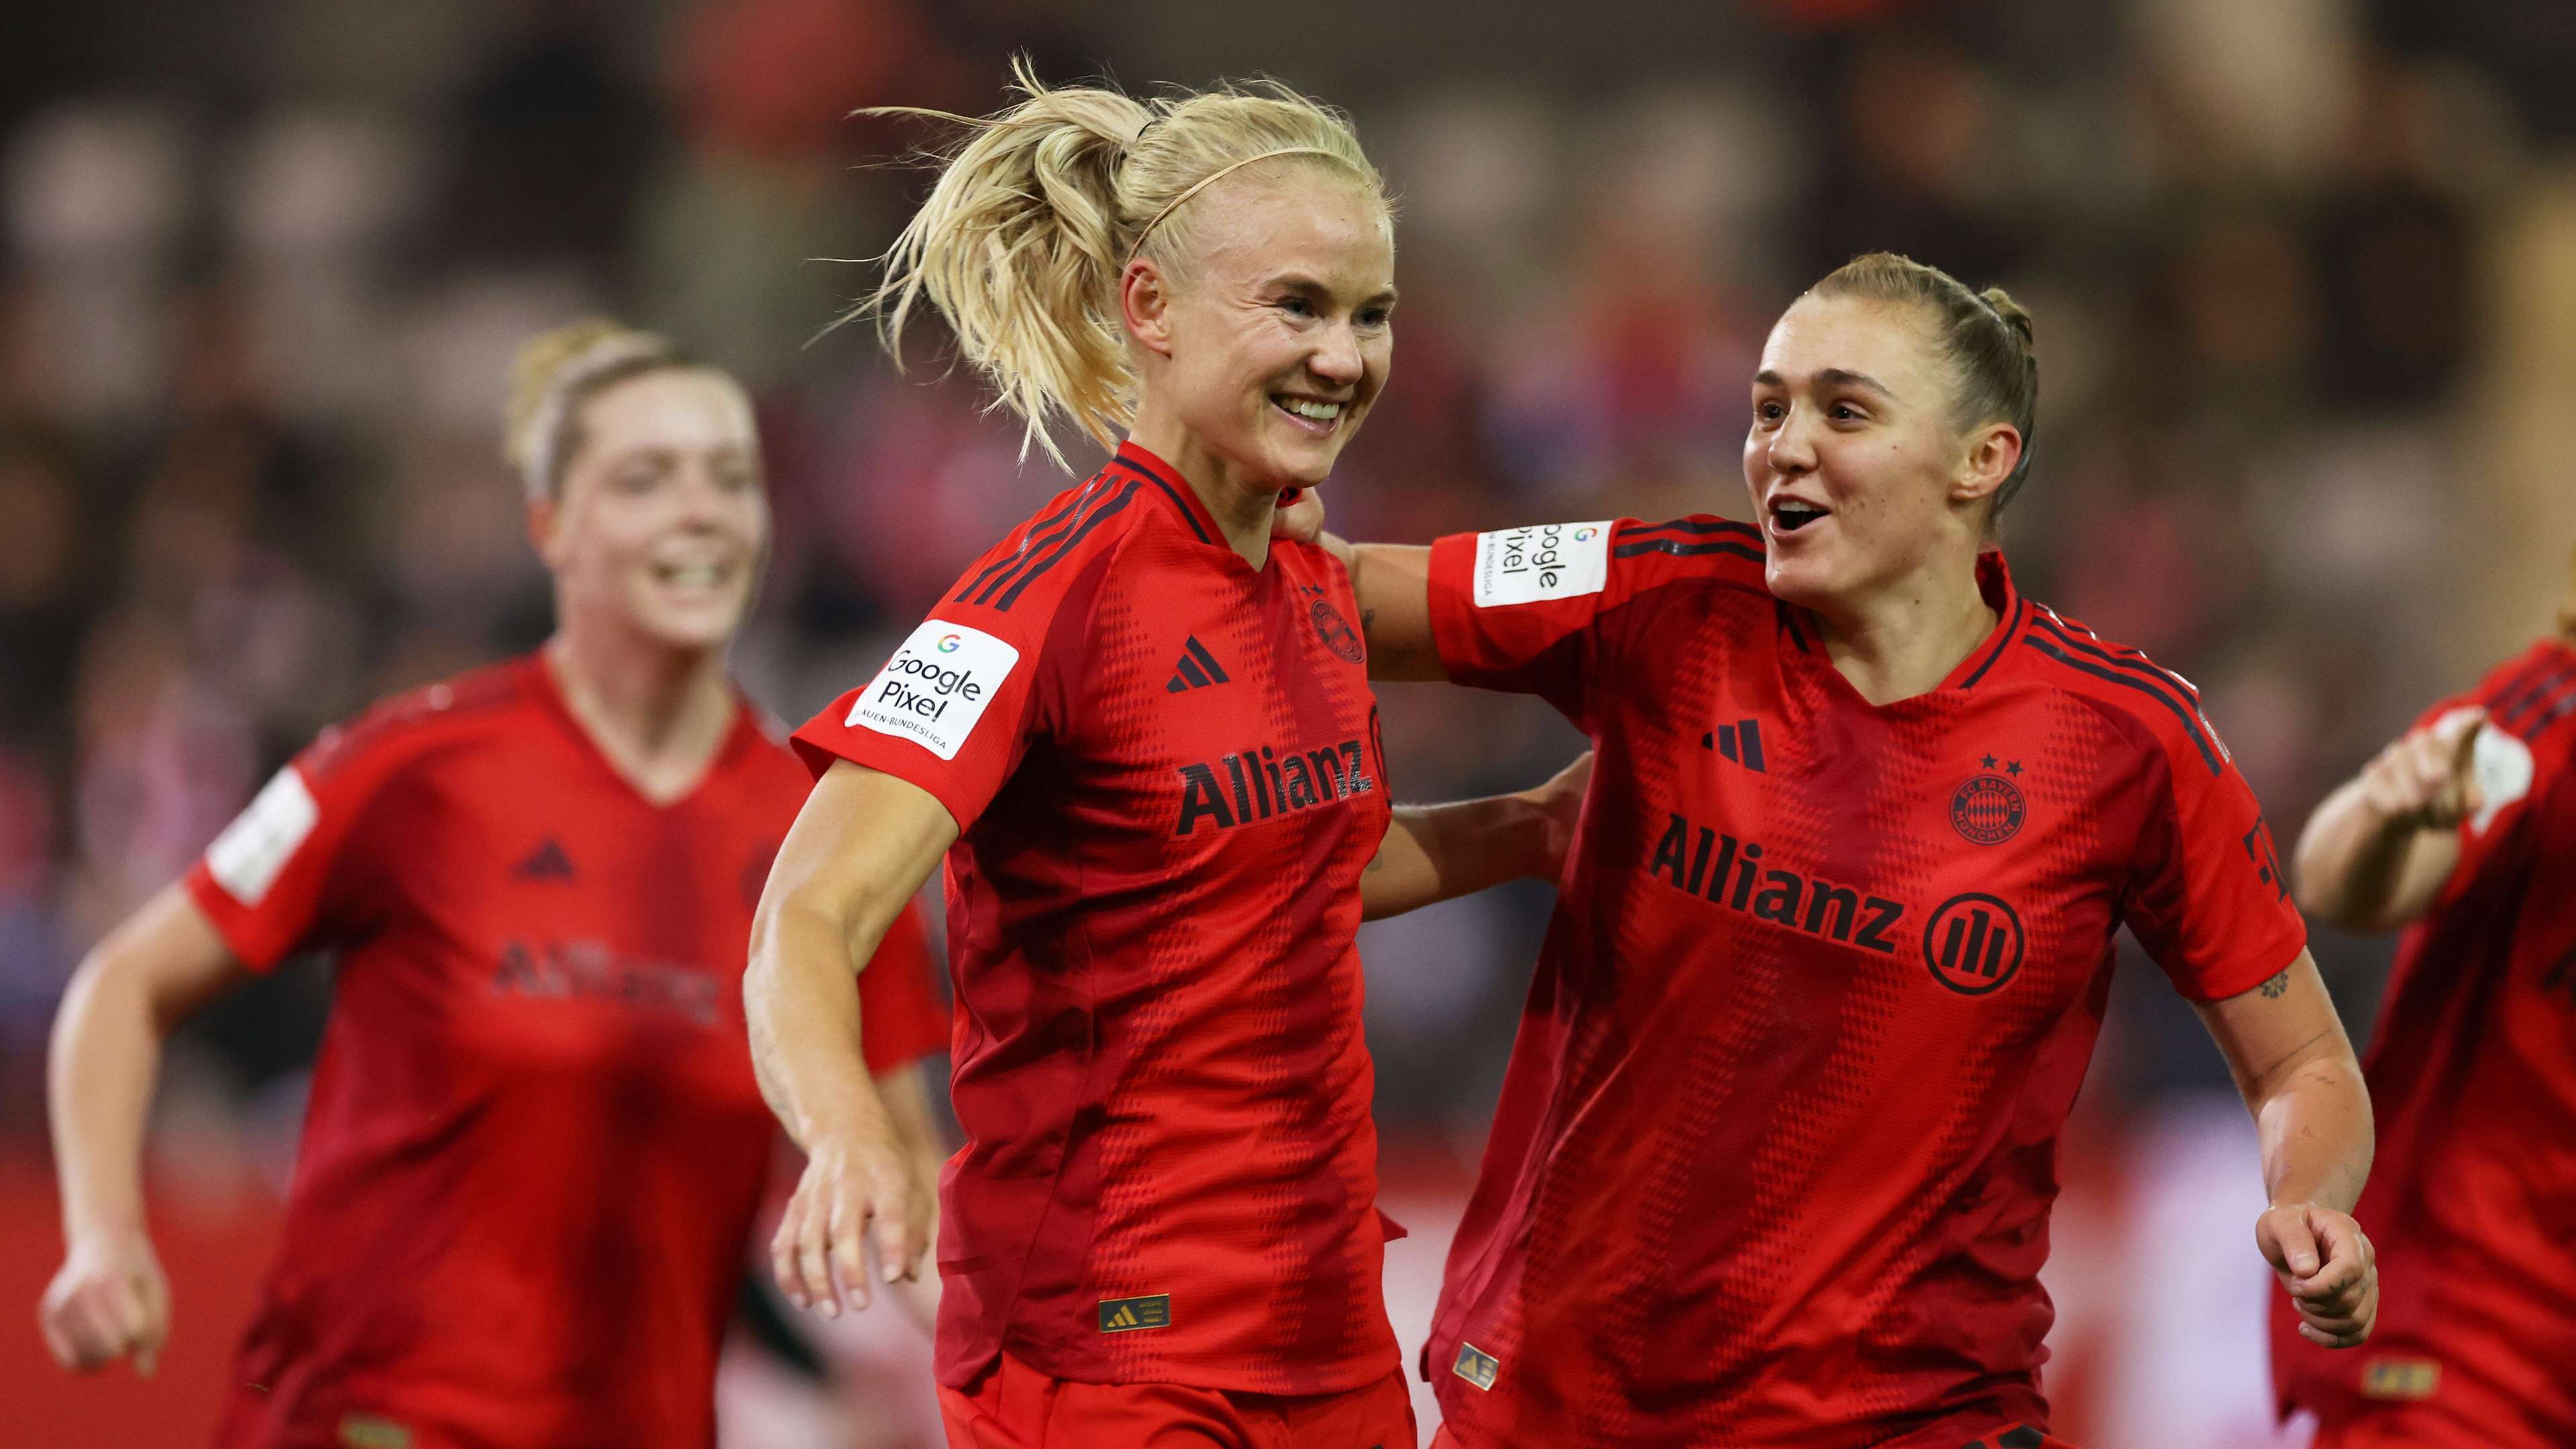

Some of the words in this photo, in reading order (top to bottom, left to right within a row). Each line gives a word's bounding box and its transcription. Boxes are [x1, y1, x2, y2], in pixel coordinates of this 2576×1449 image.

[877, 681, 949, 722] Pixel
[888, 650, 981, 701] Google
[1176, 740, 1373, 835] Allianz
[1650, 812, 1904, 954] Allianz
